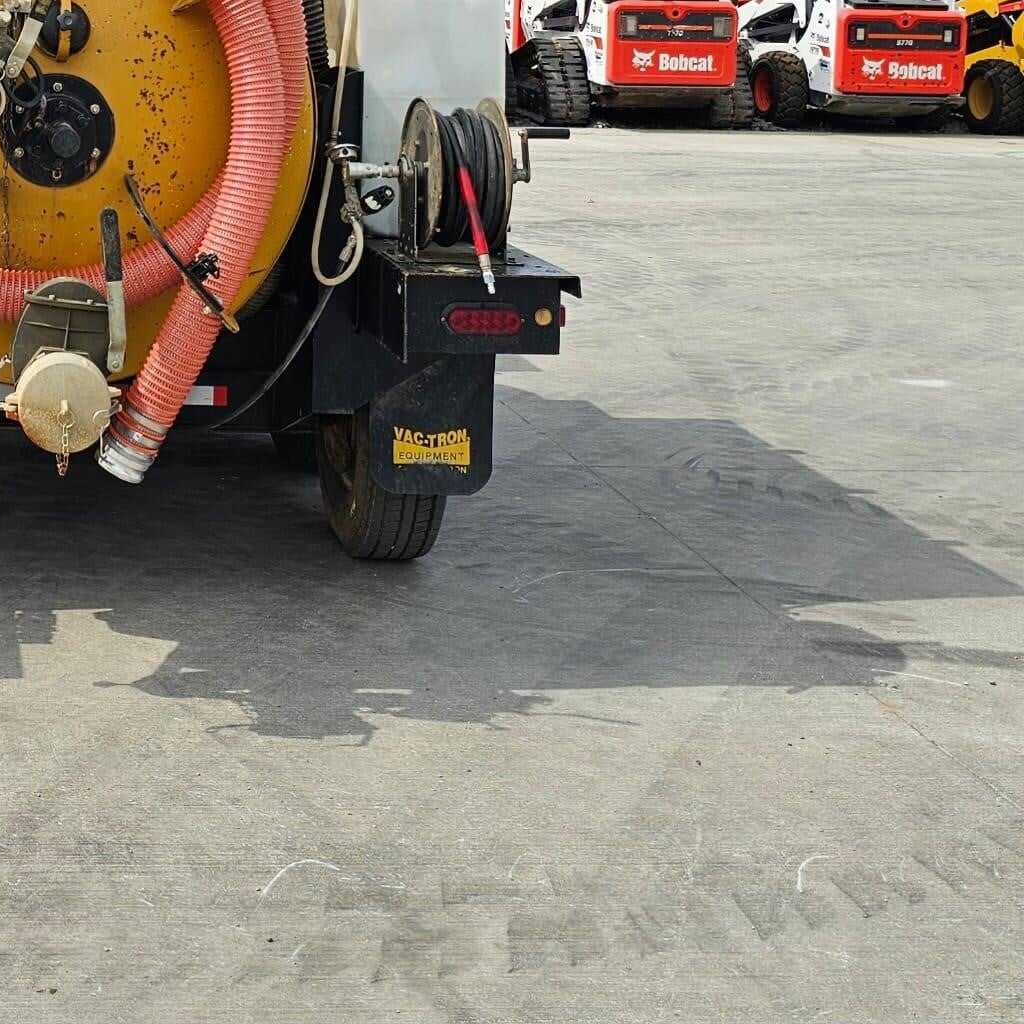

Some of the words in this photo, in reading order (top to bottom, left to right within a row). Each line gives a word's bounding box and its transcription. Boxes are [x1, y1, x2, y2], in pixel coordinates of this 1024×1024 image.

[659, 53, 713, 72] Bobcat
[888, 61, 942, 80] Bobcat
[399, 451, 464, 461] EQUIPMENT
